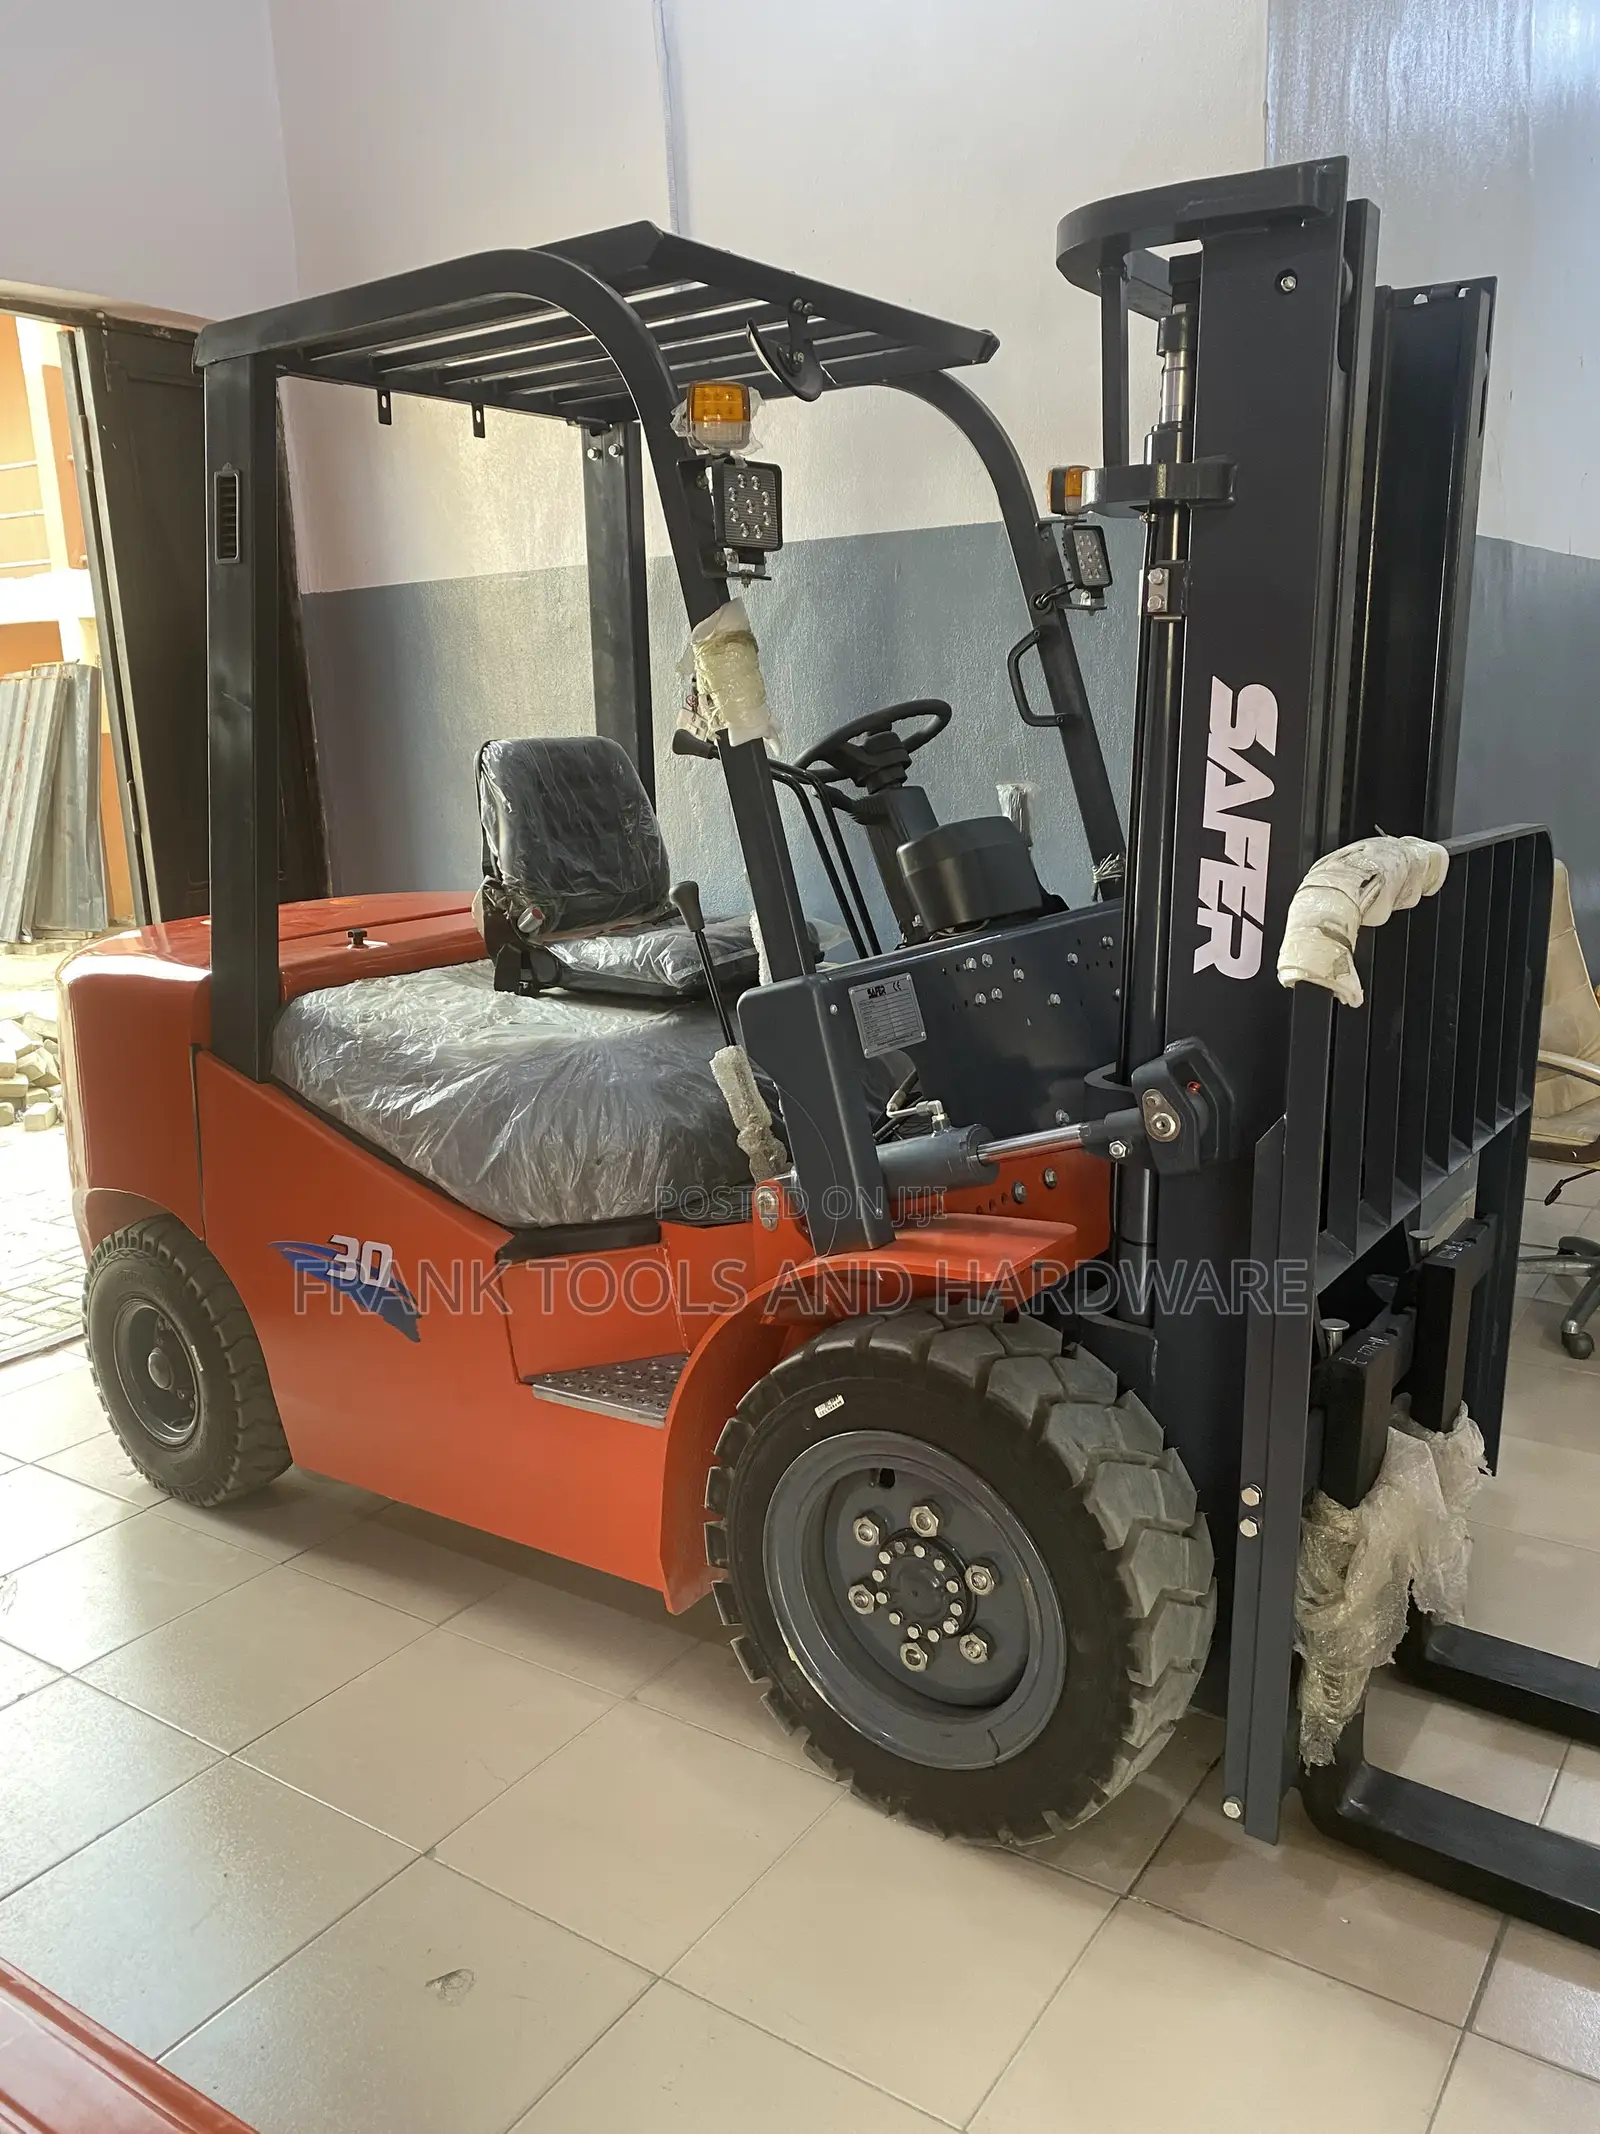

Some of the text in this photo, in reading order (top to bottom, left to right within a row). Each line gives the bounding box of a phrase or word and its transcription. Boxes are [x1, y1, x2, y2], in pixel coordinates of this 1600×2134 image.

[1193, 675, 1278, 980] SAFER
[867, 985, 887, 1000] SAFER
[326, 1234, 393, 1288] 30
